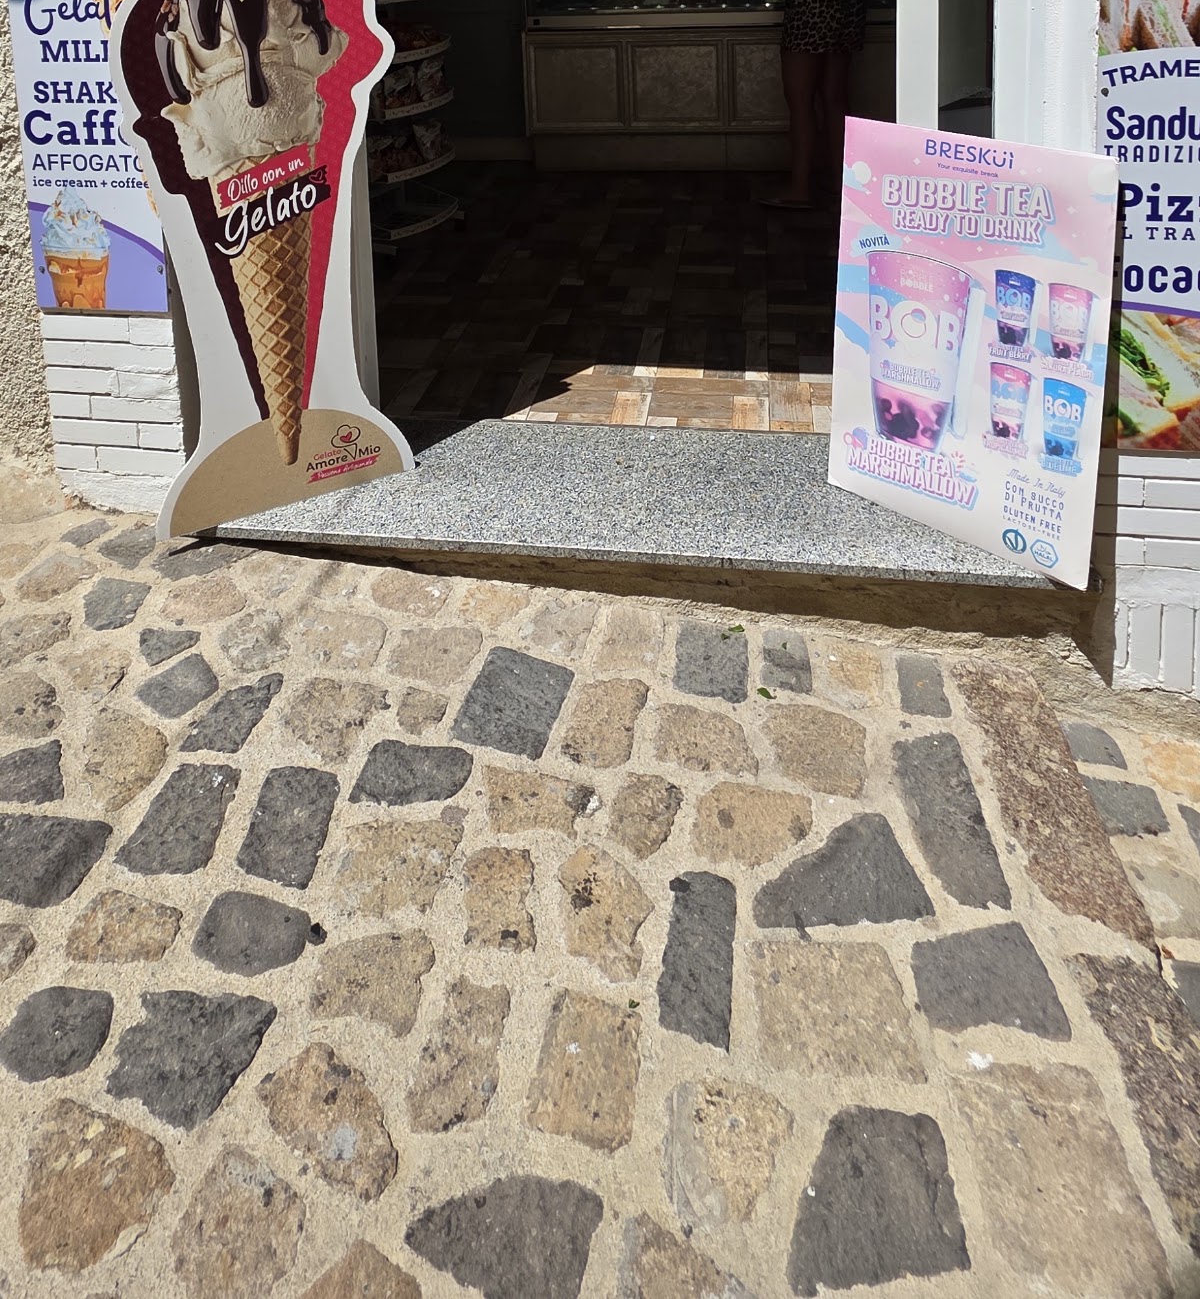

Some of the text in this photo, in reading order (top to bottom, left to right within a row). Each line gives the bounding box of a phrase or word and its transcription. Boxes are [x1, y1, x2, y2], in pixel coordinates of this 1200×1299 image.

[1102, 59, 1200, 87] TRAME
[23, 109, 130, 146] Caff
[1104, 145, 1200, 163] TRADIZI
[33, 176, 52, 187] ice
[54, 180, 98, 188] cream
[100, 180, 108, 188] +
[227, 174, 258, 201] Dillo
[288, 158, 304, 172] un
[937, 162, 998, 178] Your exquisite break
[883, 175, 1052, 219] BUBBLE TEA
[1118, 183, 1200, 222] Piz
[894, 207, 1042, 243] READY TO DRINK
[859, 234, 890, 249] NOVITÀ
[997, 286, 1031, 311] BOB
[870, 295, 960, 357] BOB
[1044, 395, 1082, 422] BOB
[306, 445, 381, 472] Amore Mio
[313, 449, 342, 461] Gelato
[870, 438, 954, 478] BUBBLE TEA
[849, 447, 975, 505] MARSHMALLOW
[1006, 468, 1030, 484] Made
[1045, 482, 1066, 498] Italy
[1005, 492, 1014, 503] DI
[1031, 492, 1064, 511] SUCCO
[1003, 505, 1062, 534] GLUTEN FREE
